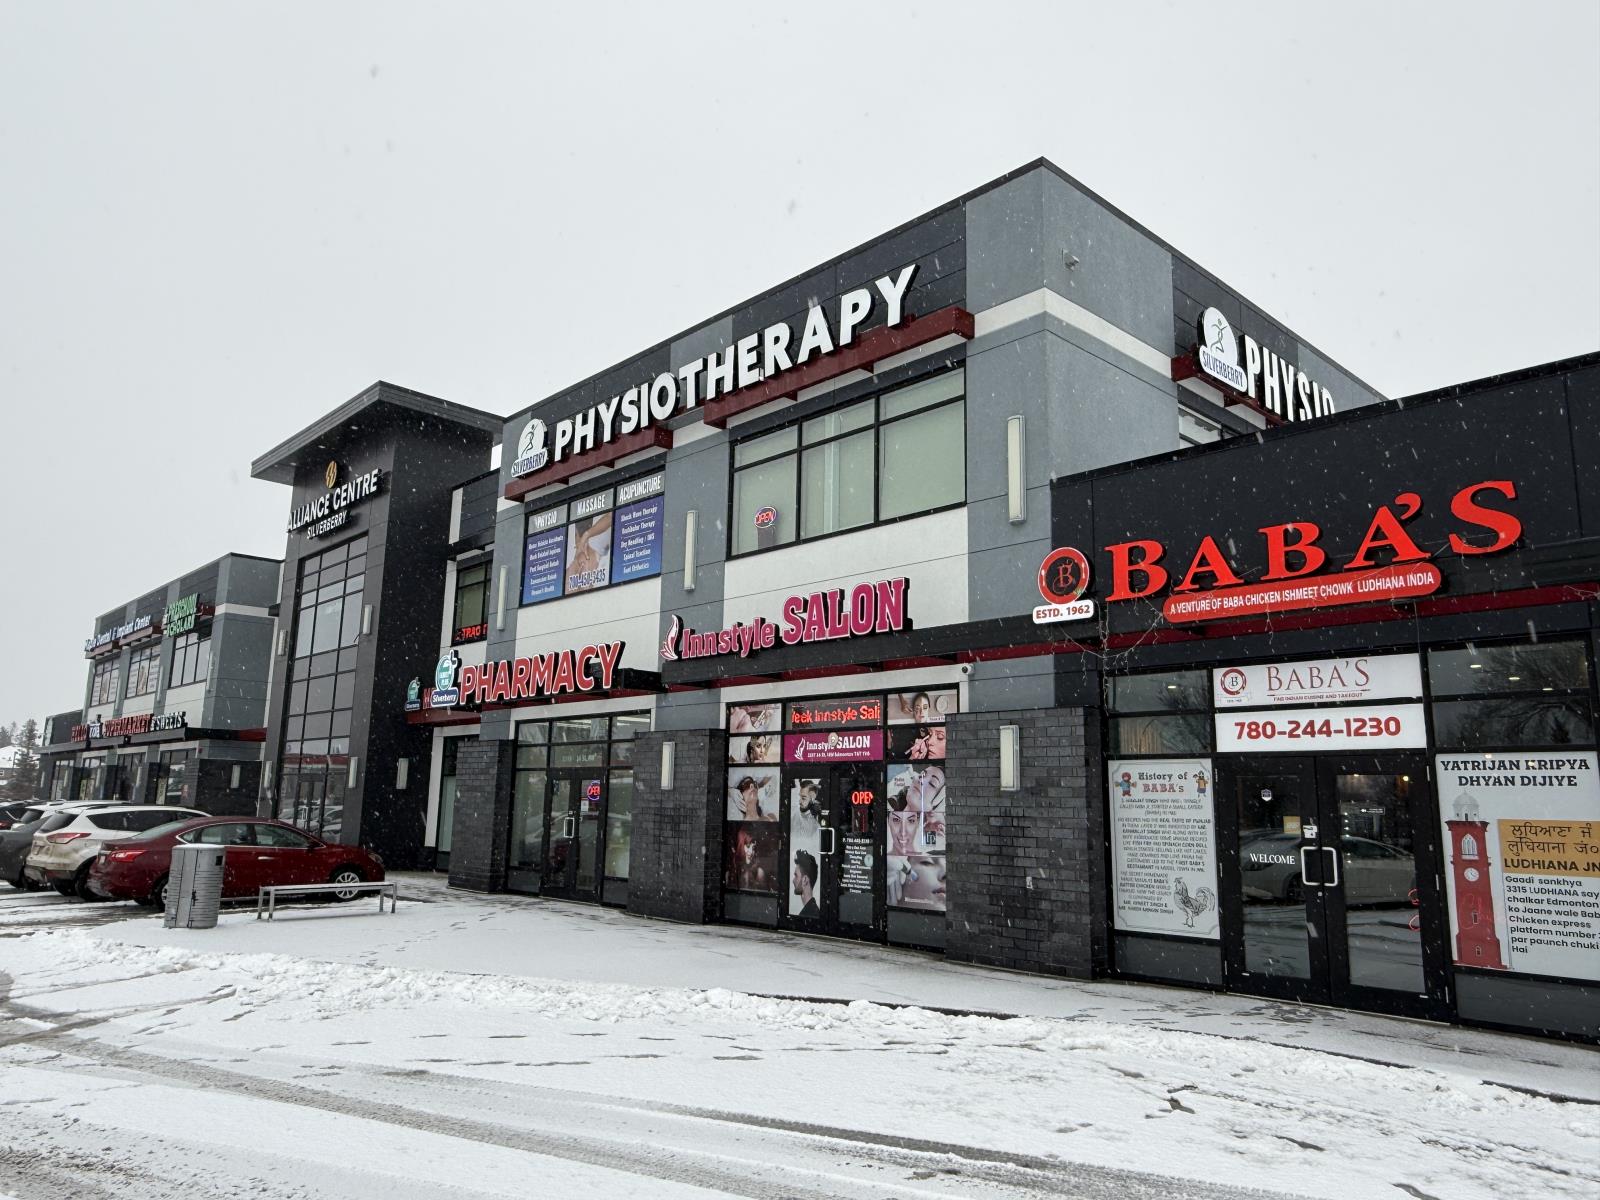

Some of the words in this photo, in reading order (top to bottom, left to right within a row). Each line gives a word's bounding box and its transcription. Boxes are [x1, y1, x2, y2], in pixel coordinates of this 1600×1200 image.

[554, 263, 917, 462] PHYSIOTHERAPY
[1202, 350, 1244, 388] SILVERBERRY
[512, 450, 546, 476] SILVERBERRY
[619, 475, 662, 502] ACUPUNCTURE
[288, 493, 330, 531] ALLIANCE
[333, 468, 379, 510] CENTRE
[576, 494, 606, 515] MASSAGE
[306, 510, 347, 539] SILVERBERRY
[537, 510, 557, 529] PHYSIO
[1104, 480, 1524, 602] BABA'S
[1170, 602, 1176, 614] A
[1176, 599, 1211, 614] VENTURE
[1211, 598, 1222, 610] OF
[1223, 596, 1244, 609] BABA
[1245, 591, 1281, 606] CHICKEN
[1282, 588, 1318, 602] ISHMEET
[1320, 582, 1353, 598] CHOWK
[1357, 576, 1405, 593] LUDHIANA
[1406, 572, 1434, 587] INDIA
[681, 616, 776, 659] Innstyle
[781, 577, 906, 645] SALON
[1036, 608, 1063, 619] ESTD.
[1066, 604, 1090, 615] 1962
[460, 641, 621, 705] PHARMACY
[1265, 659, 1370, 692] BABA'S
[156, 711, 183, 730] SWEETS
[815, 706, 857, 724] Innstyle
[1234, 716, 1401, 740] 780-244-1230
[836, 735, 871, 749] SALON
[1440, 759, 1521, 771] YATRIJAN
[1525, 759, 1590, 770] KRIPYA
[1138, 772, 1173, 782] History
[1177, 772, 1188, 780] of
[1458, 775, 1516, 787] DHYAN
[1520, 775, 1578, 787] DIJIYE
[1142, 783, 1184, 793] BABA's
[1249, 853, 1296, 865] WELCOME
[1504, 858, 1579, 872] LUDHIANA
[1538, 878, 1583, 888] sankhya
[1506, 885, 1527, 894] 3315
[1529, 887, 1579, 897] LUDHIANA
[1581, 891, 1600, 900] say
[1507, 896, 1545, 905] chalkar
[1546, 898, 1599, 908] Edmonton
[1522, 906, 1552, 914] Jaane
[1554, 909, 1579, 917] wale
[1509, 915, 1549, 925] Chicken
[1551, 920, 1592, 929] express
[1510, 926, 1553, 935] platform
[1555, 930, 1596, 939] number
[1511, 936, 1528, 944] par
[1530, 938, 1568, 947] paunch
[1570, 941, 1600, 950] chuki
